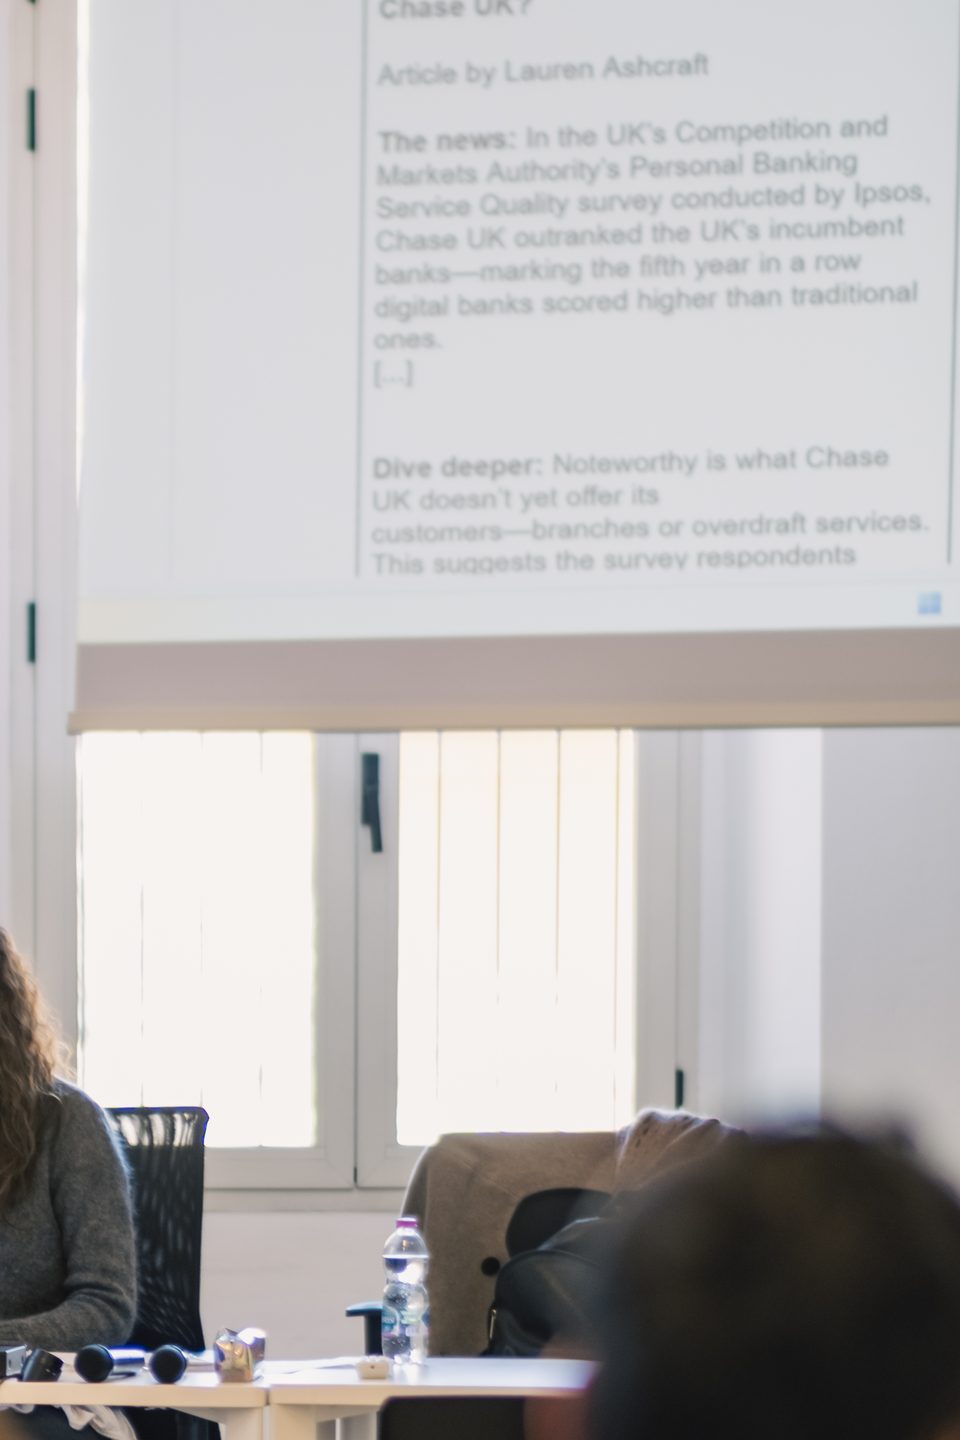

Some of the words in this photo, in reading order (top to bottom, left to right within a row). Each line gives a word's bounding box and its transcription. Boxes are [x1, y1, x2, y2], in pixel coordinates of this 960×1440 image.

[379, 0, 466, 20] Chase
[378, 63, 458, 86] Article
[466, 62, 496, 88] by
[505, 60, 595, 83] Lauren
[602, 53, 709, 79] Ashcraft
[378, 131, 428, 152] The
[437, 130, 516, 152] news:
[527, 127, 550, 149] In
[558, 126, 598, 147] the
[607, 122, 667, 147] UK's
[675, 119, 832, 147] Competition
[840, 115, 889, 138] and
[377, 165, 479, 186] Markets
[487, 160, 621, 186] Authority's
[630, 154, 744, 178] Personal
[753, 151, 859, 178] Banking
[377, 197, 472, 220] Service
[479, 194, 569, 219] Quality
[578, 194, 663, 216] survey
[671, 185, 806, 210] conducted
[814, 184, 845, 210] by
[854, 182, 932, 209] Ipsos,
[376, 229, 459, 253] Chase
[467, 228, 505, 250] UK
[515, 223, 643, 249] outranked
[651, 223, 692, 244] the
[700, 219, 761, 243] UK's
[769, 216, 905, 240] incumbent
[591, 258, 631, 279] the
[639, 255, 686, 277] fifth
[694, 257, 750, 281] year
[759, 256, 782, 274] in
[789, 256, 806, 274] a
[814, 255, 862, 272] row
[374, 297, 449, 324] digital
[457, 296, 534, 317] banks
[543, 290, 629, 314] scored
[637, 289, 717, 317] higher
[725, 287, 783, 309] than
[791, 281, 919, 307] traditional
[373, 331, 443, 350] ones.
[373, 457, 433, 480] Dive
[441, 456, 543, 482] deeper:
[553, 451, 698, 476] Noteworthy
[706, 448, 727, 472] is
[735, 449, 797, 470] what
[805, 446, 890, 469] Chase
[372, 490, 410, 512] UK
[419, 489, 513, 511] doesn't
[520, 488, 558, 513] yet
[566, 485, 623, 507] offer
[631, 484, 660, 506] its
[658, 520, 684, 538] or
[692, 512, 807, 537] overdraft
[815, 514, 930, 534] services.
[374, 554, 425, 575] This
[434, 554, 547, 575] suggests
[555, 551, 595, 571] the
[604, 552, 688, 570] survey
[696, 546, 857, 569] respondents
